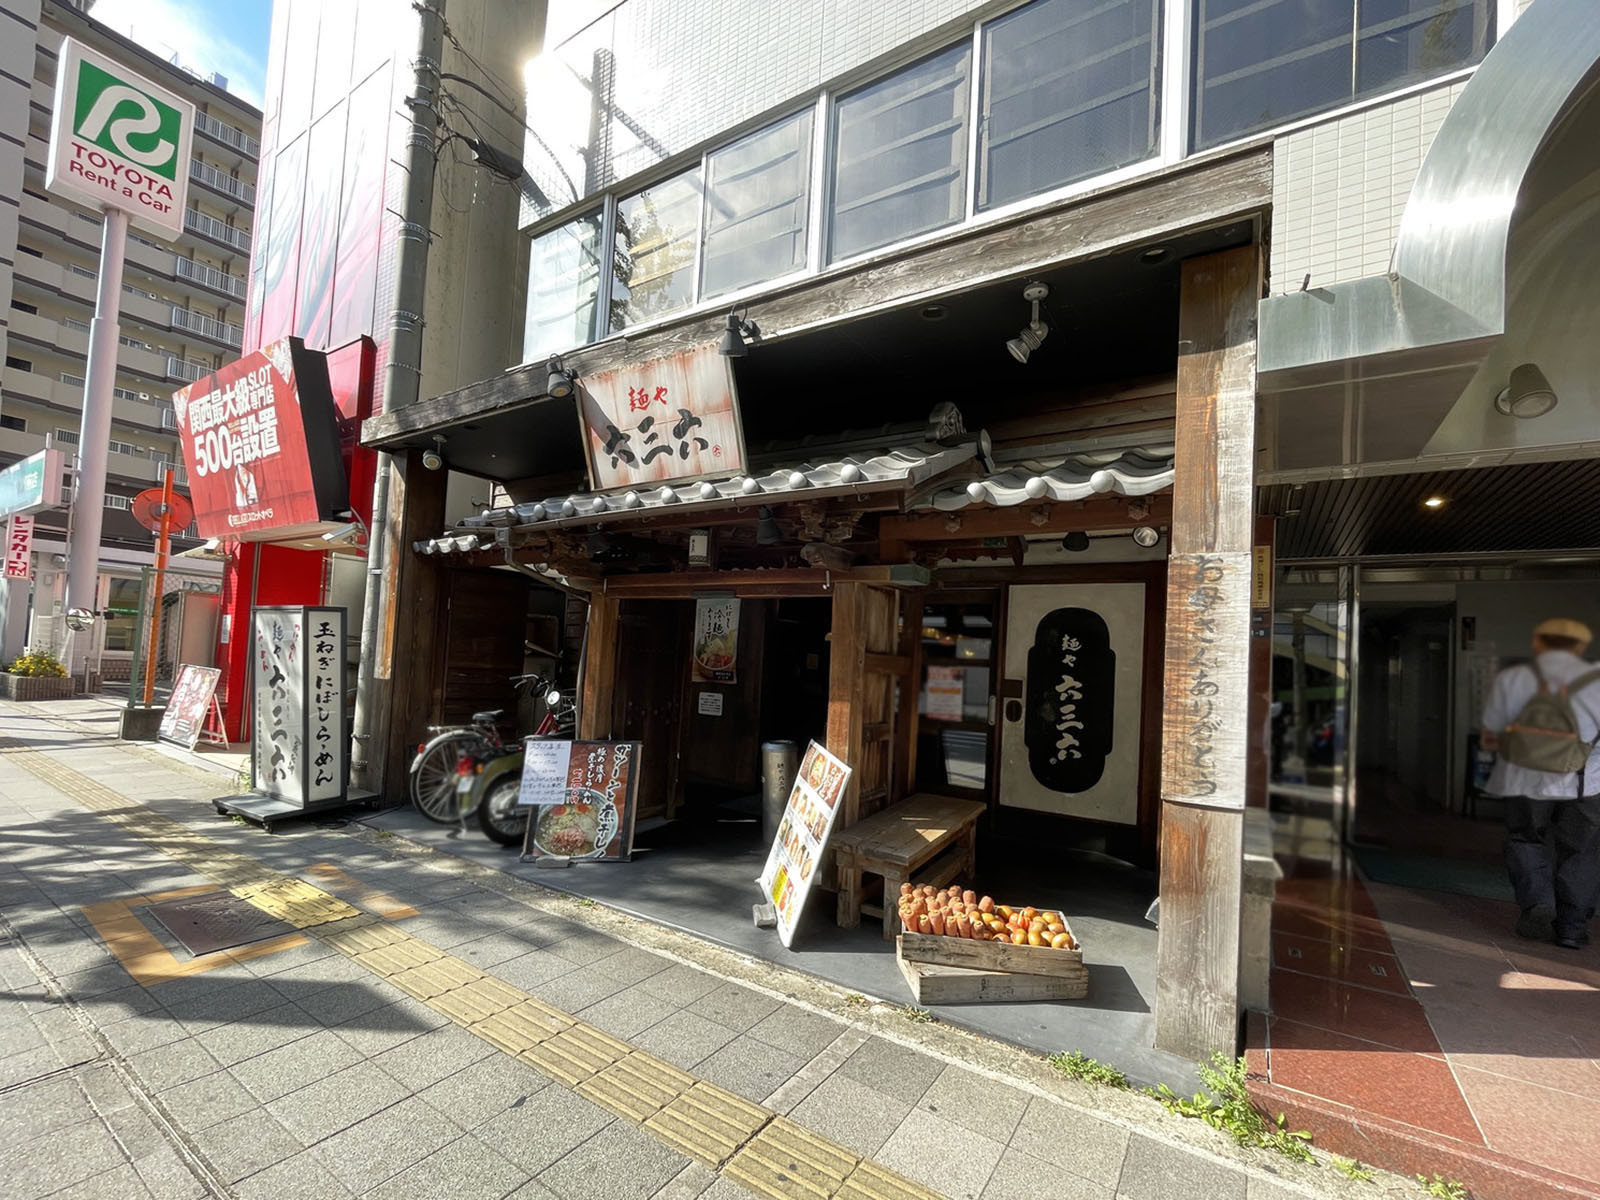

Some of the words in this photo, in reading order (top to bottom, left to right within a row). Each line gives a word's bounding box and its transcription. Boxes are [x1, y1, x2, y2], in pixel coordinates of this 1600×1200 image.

[69, 159, 117, 193] Rent
[122, 185, 133, 200] a
[138, 191, 173, 215] Car
[71, 142, 174, 201] TOYOTA
[189, 377, 250, 435] 関西最大級
[248, 364, 272, 391] SLOT
[250, 384, 274, 410] 専門店
[628, 386, 668, 412] 麺や
[194, 406, 280, 477] 500台設置
[603, 408, 709, 470] 六三六
[1189, 554, 1224, 797] お母さんありがとう
